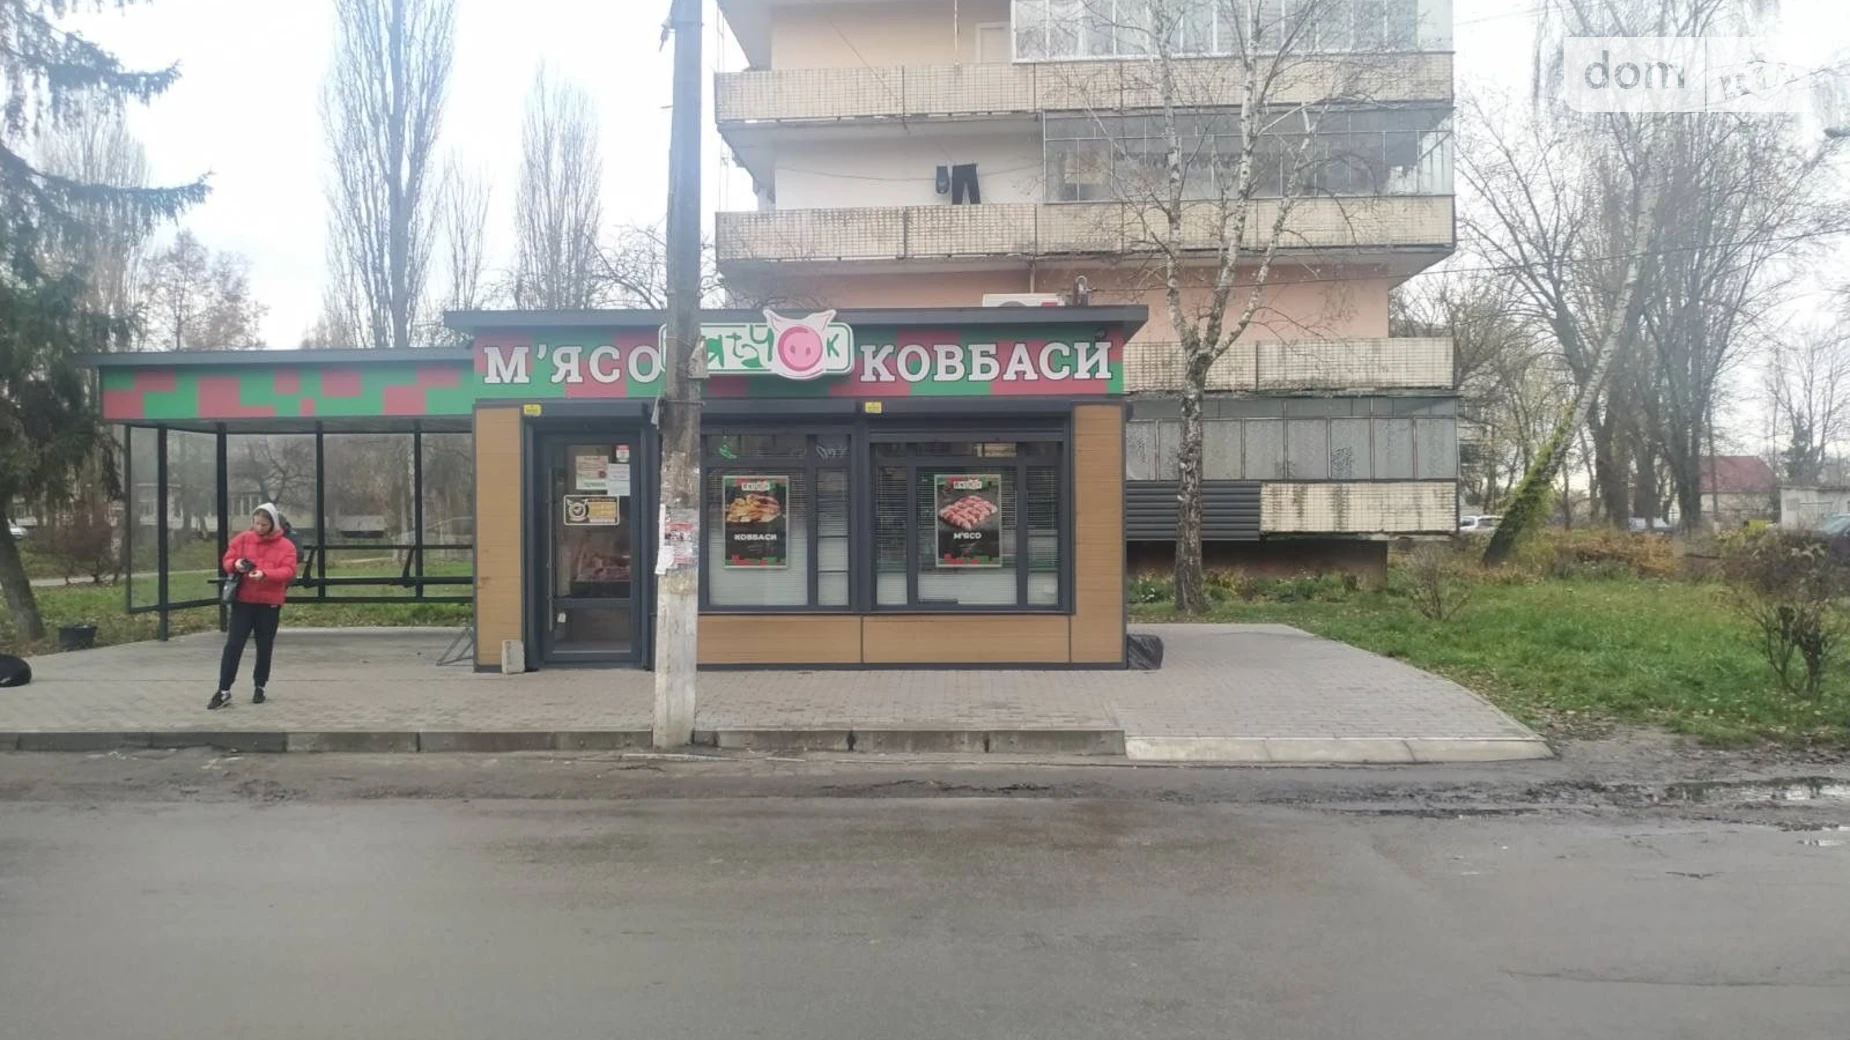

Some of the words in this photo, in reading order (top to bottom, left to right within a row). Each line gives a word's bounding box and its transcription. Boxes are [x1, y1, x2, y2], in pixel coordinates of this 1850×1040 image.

[484, 345, 661, 384] М'ЯСО
[860, 342, 1112, 382] КОВБАСИ
[734, 533, 777, 541] КОВБАСИ
[953, 532, 982, 540] М'ЯСО
